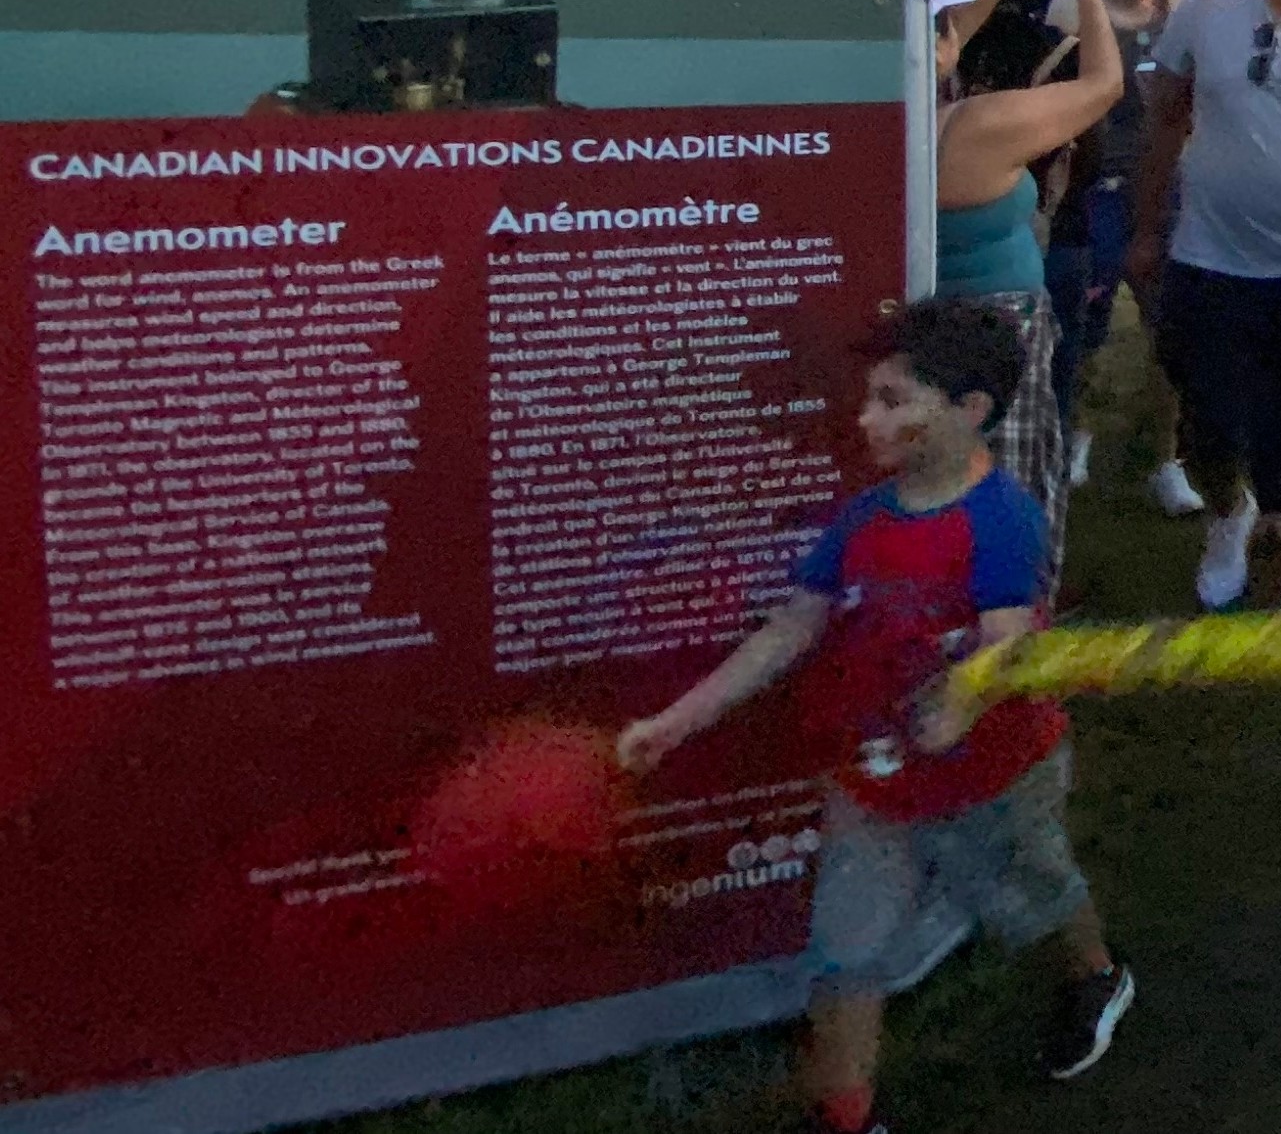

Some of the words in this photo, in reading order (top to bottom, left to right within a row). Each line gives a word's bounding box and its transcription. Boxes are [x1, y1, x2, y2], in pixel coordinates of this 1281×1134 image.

[29, 148, 263, 181] CANADIAN
[274, 139, 563, 173] INNOVATIONS
[571, 131, 831, 163] CANADIENNES
[487, 196, 760, 235] Anémomètre
[33, 217, 346, 258] Anemometer
